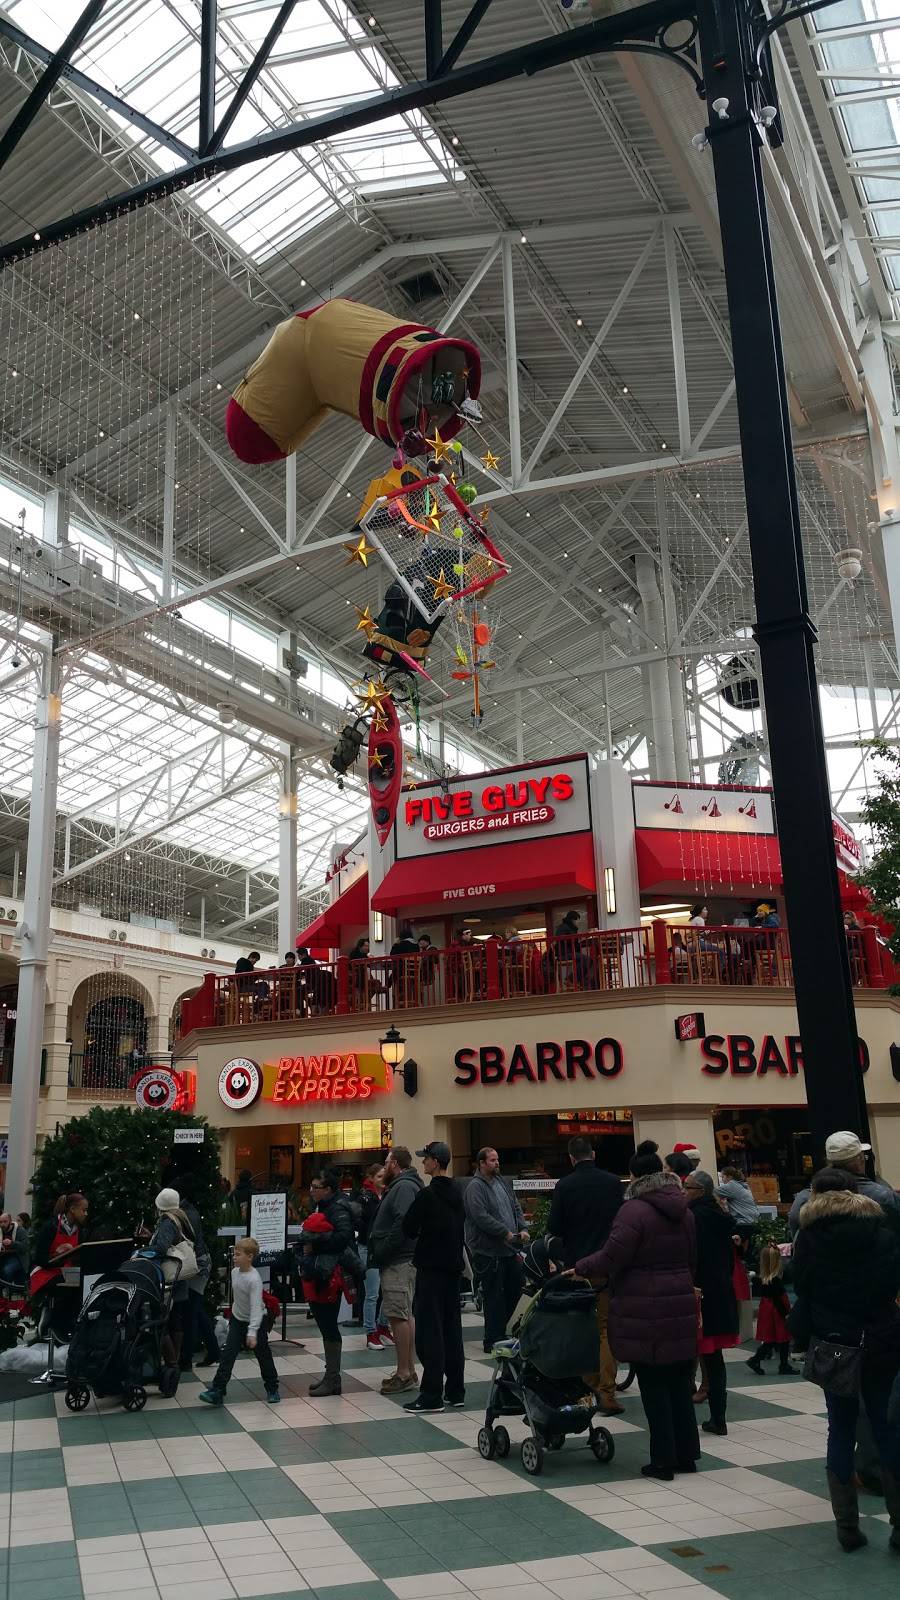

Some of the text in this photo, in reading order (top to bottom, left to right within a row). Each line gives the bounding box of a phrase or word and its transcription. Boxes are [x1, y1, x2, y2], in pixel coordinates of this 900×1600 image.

[405, 773, 574, 825] FIVE GUYS
[428, 807, 548, 838] BURGERS and FRIES
[443, 884, 496, 900] FIVE GUYS
[279, 1053, 357, 1080] PANDA
[454, 1037, 624, 1086] SBARRO
[701, 1035, 870, 1074] SBARO
[137, 1074, 176, 1094] PANDA EXPRESS
[219, 1060, 258, 1084] PANDA EXPRESS
[273, 1077, 374, 1103] EXPRESS
